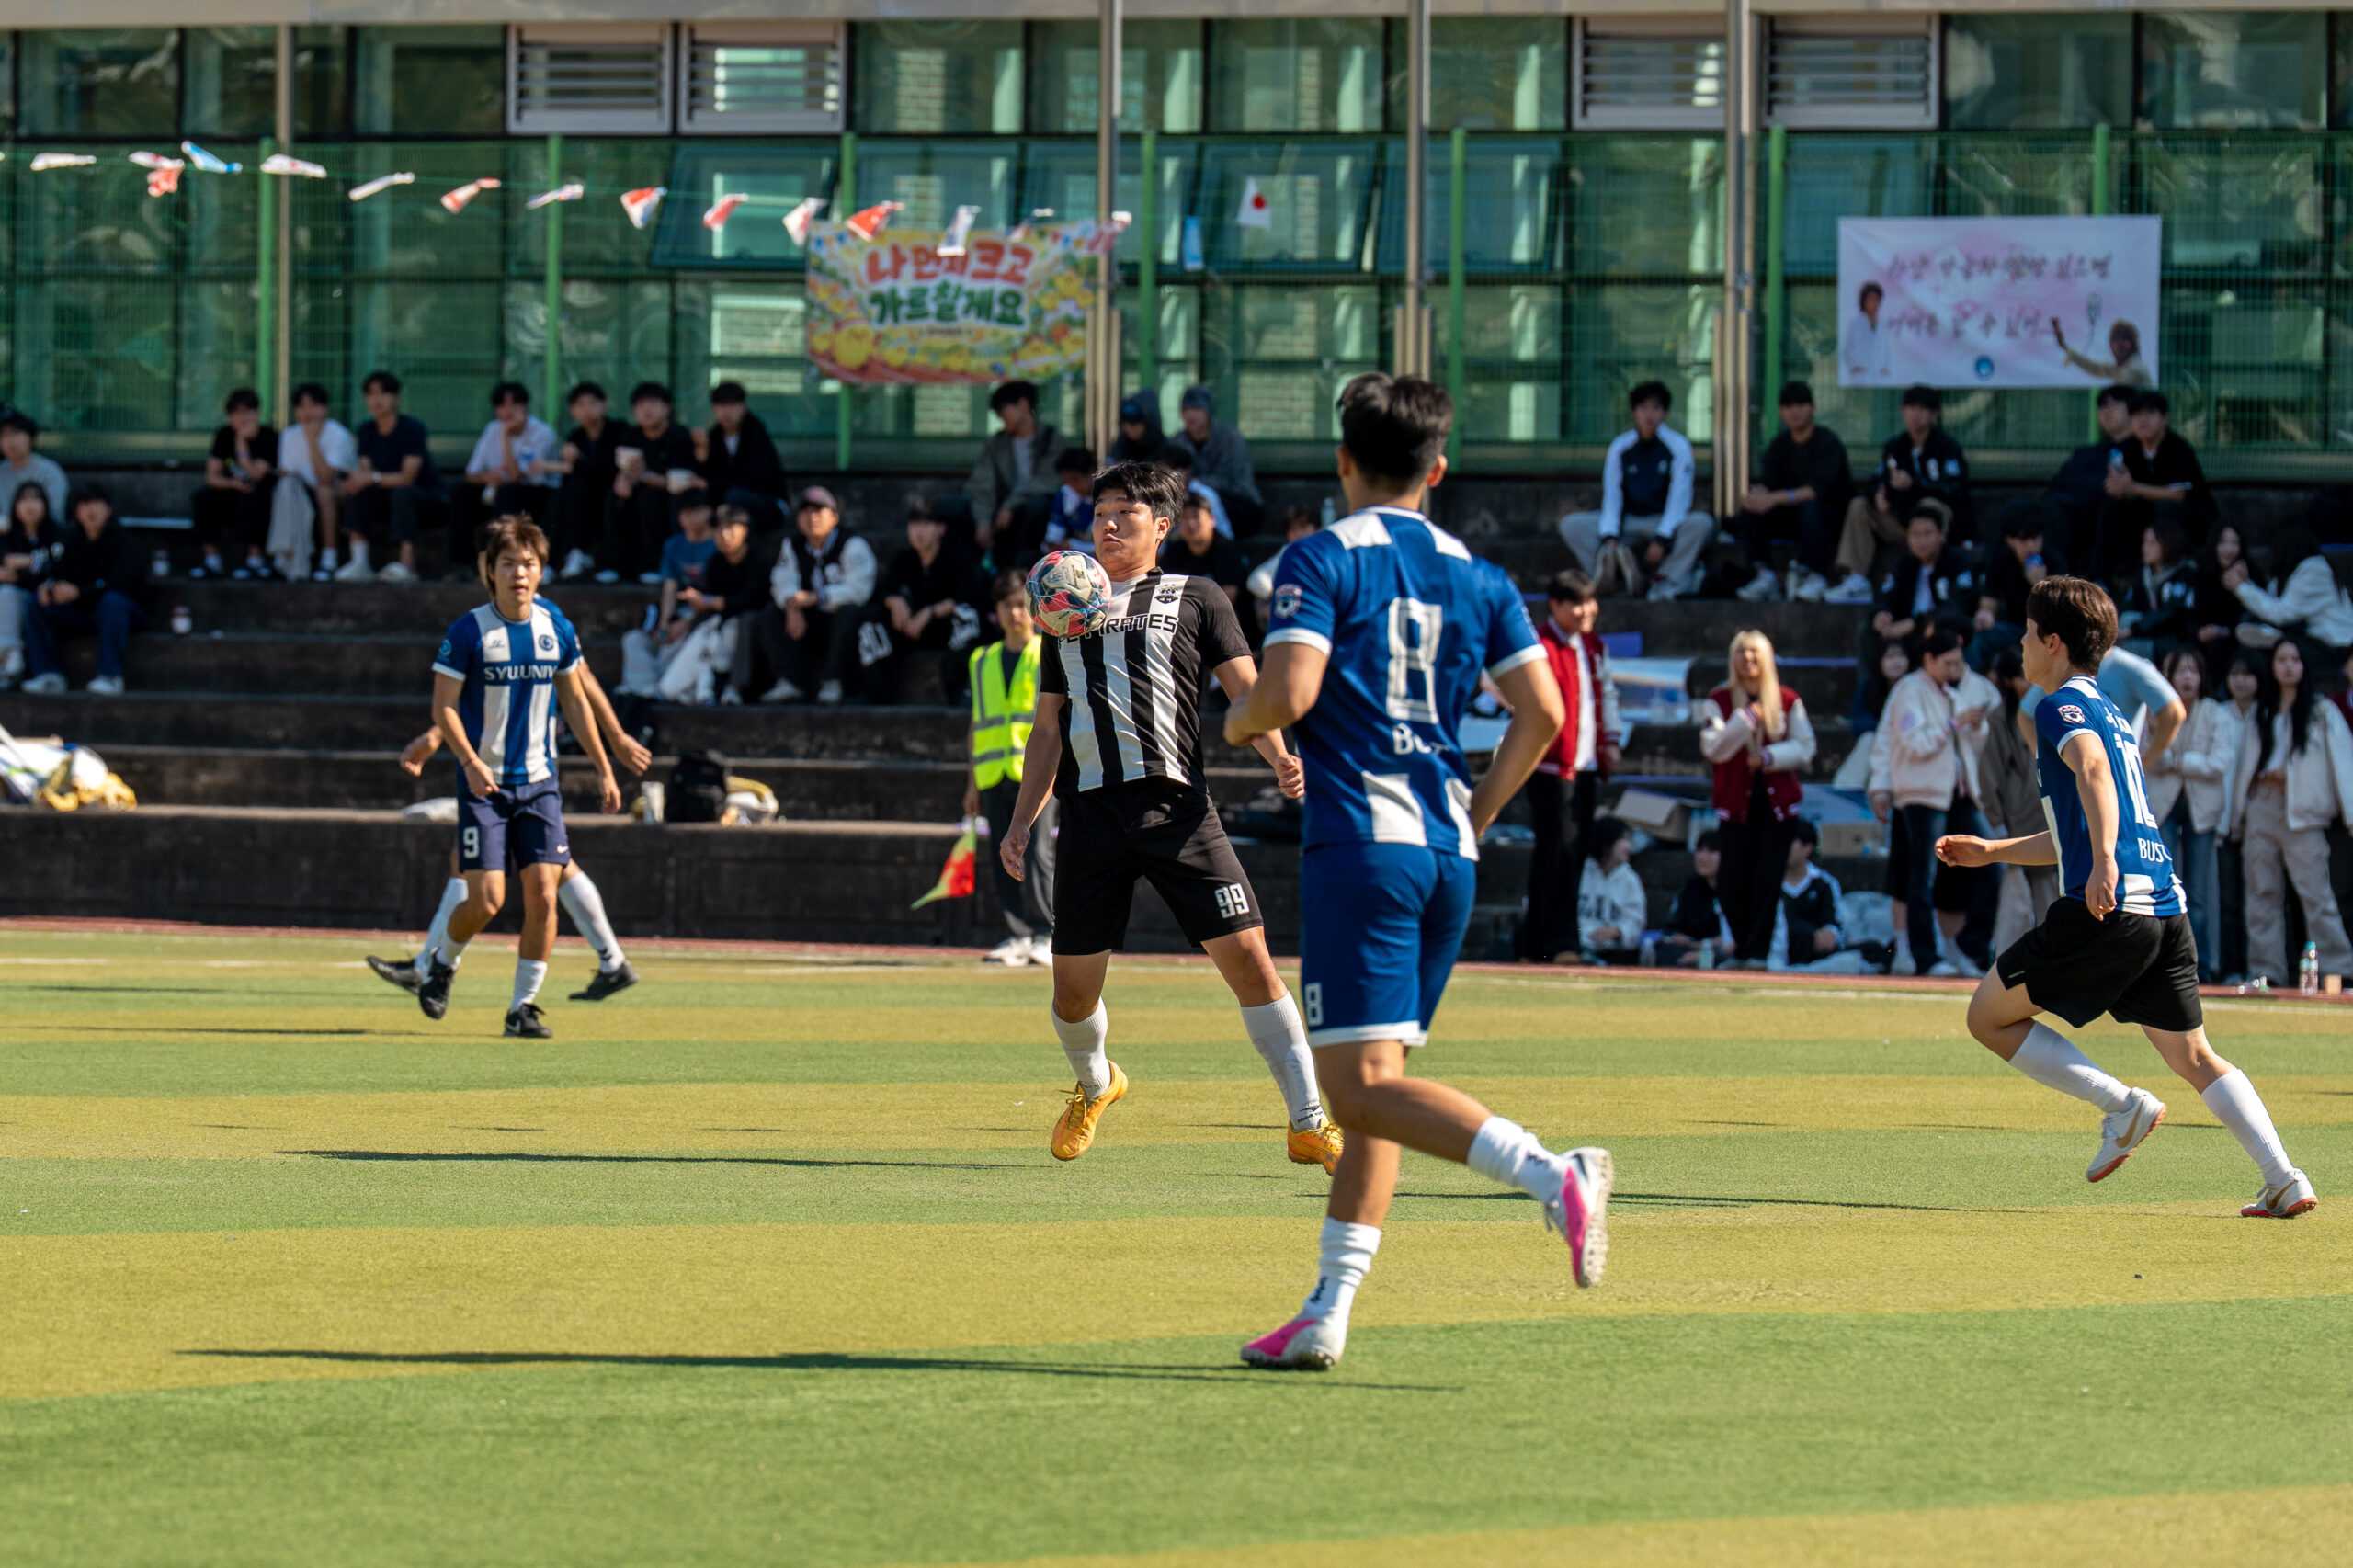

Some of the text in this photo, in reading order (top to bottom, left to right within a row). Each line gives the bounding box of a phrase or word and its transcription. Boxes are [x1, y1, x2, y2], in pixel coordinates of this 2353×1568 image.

[1386, 597, 1443, 724] 8
[463, 826, 480, 858] 9
[1214, 882, 1250, 919] 99
[1304, 981, 1324, 1027] 8
